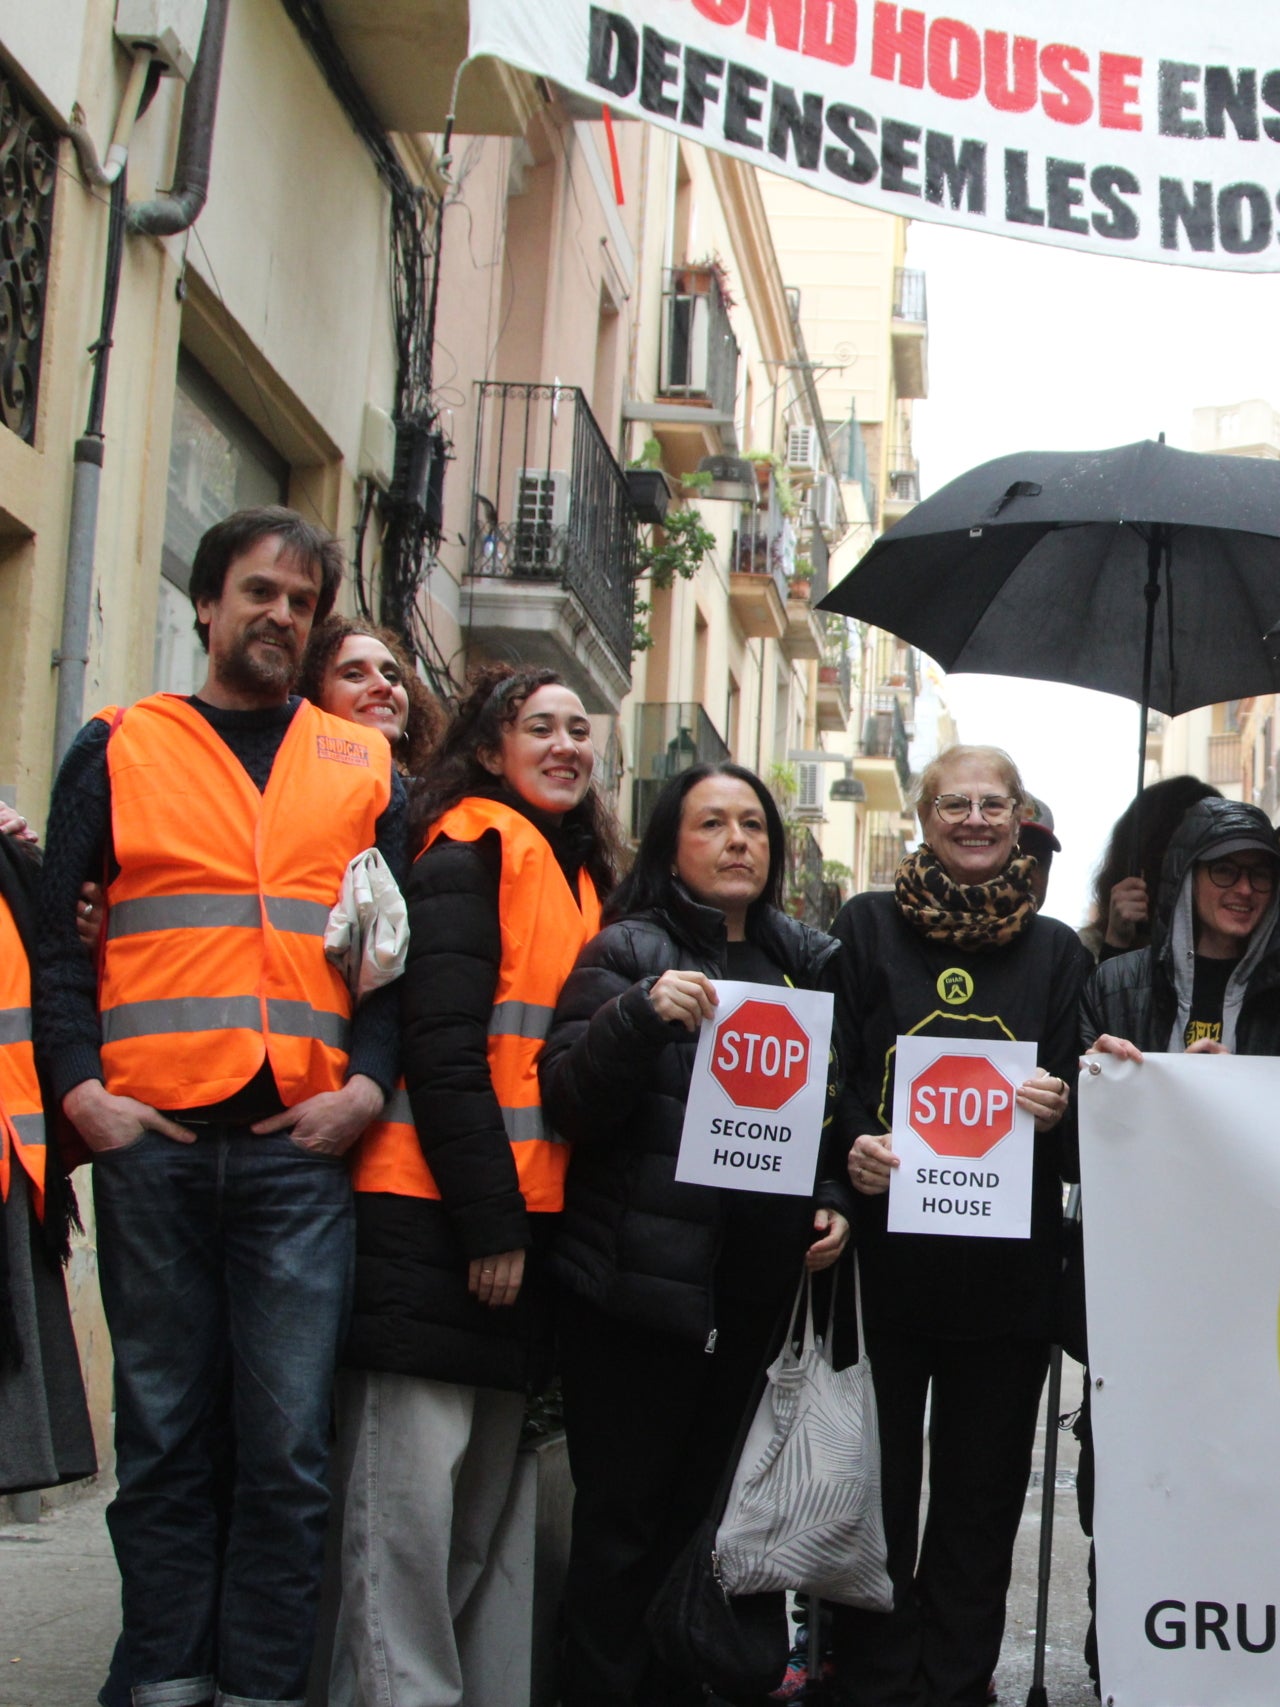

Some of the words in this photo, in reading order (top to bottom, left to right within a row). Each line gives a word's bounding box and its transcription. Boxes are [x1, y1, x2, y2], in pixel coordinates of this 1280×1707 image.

[872, 2, 1142, 131] HOUSE
[586, 5, 987, 216] DEFENSEM
[1005, 149, 1139, 240] LES
[717, 1030, 805, 1078] STOP
[914, 1085, 1008, 1127] STOP
[710, 1118, 792, 1143] SECOND
[713, 1149, 782, 1172] HOUSE
[916, 1168, 1000, 1188] SECOND
[922, 1197, 992, 1217] HOUSE
